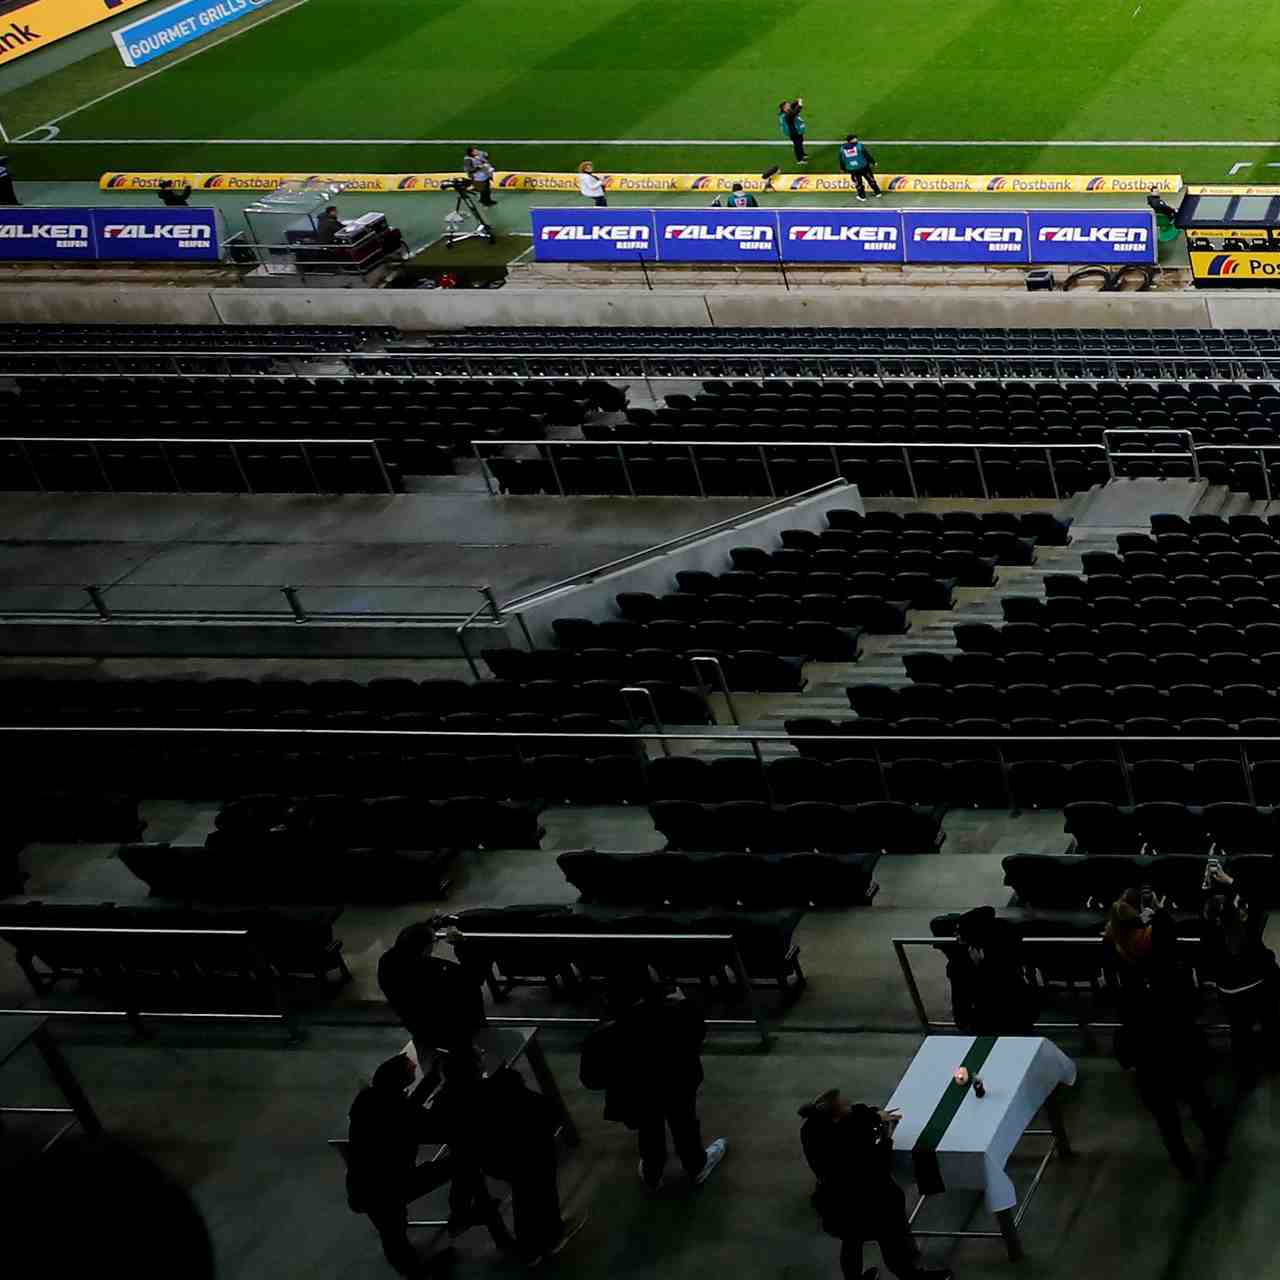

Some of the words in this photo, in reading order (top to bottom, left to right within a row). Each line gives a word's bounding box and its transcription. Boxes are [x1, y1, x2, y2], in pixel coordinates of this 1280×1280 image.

[129, 17, 198, 60] GOURMET
[619, 176, 678, 192] Postbank
[912, 176, 972, 192] Postbank
[1111, 177, 1171, 193] Postbank
[103, 224, 212, 239] FALKEN
[541, 224, 649, 241] FALKEN
[788, 224, 898, 241] FALKEN
[1038, 226, 1148, 243] FALKEN
[178, 239, 211, 248] REIFEN
[863, 241, 897, 250] REIFEN
[1113, 243, 1146, 253] REIFEN
